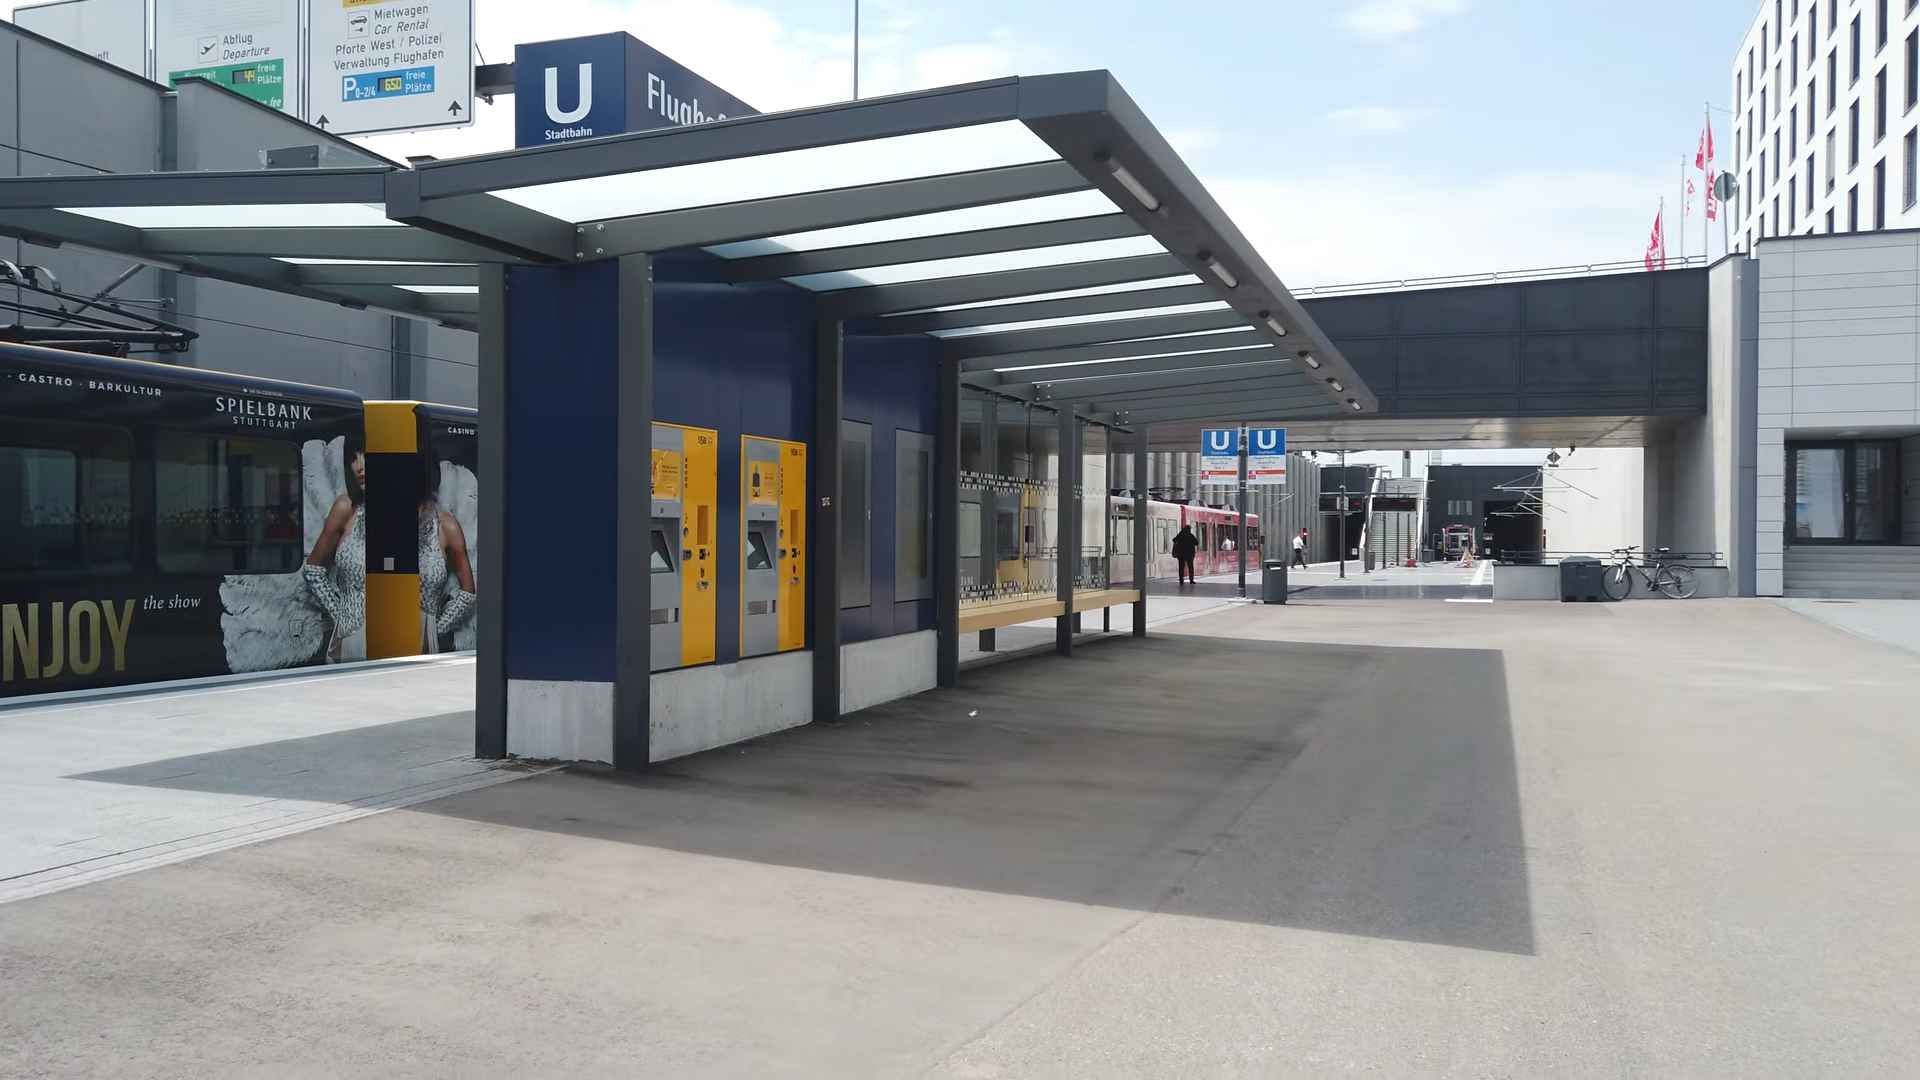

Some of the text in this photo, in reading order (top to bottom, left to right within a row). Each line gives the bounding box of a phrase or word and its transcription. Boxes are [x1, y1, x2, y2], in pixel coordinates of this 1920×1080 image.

[374, 6, 429, 20] Mietwagen
[374, 19, 429, 35] Car Rental
[223, 33, 253, 45] Abflug
[336, 42, 366, 55] Pforte
[371, 39, 395, 51] West
[408, 34, 442, 47] Polizei
[223, 46, 270, 60] Departure
[333, 49, 444, 71] Verwaltung Flughafen
[405, 71, 426, 82] freie
[405, 82, 432, 94] Plätze
[545, 63, 592, 124] U
[545, 127, 593, 140] Stadtbahn
[18, 373, 162, 397] GASTRO BARKULTUR
[216, 397, 313, 421] SPIELBANK
[232, 416, 297, 430] STUTTGART
[1211, 431, 1230, 450] U
[1257, 430, 1277, 450] U
[143, 594, 201, 610] the show
[2, 599, 136, 681] NJOY
